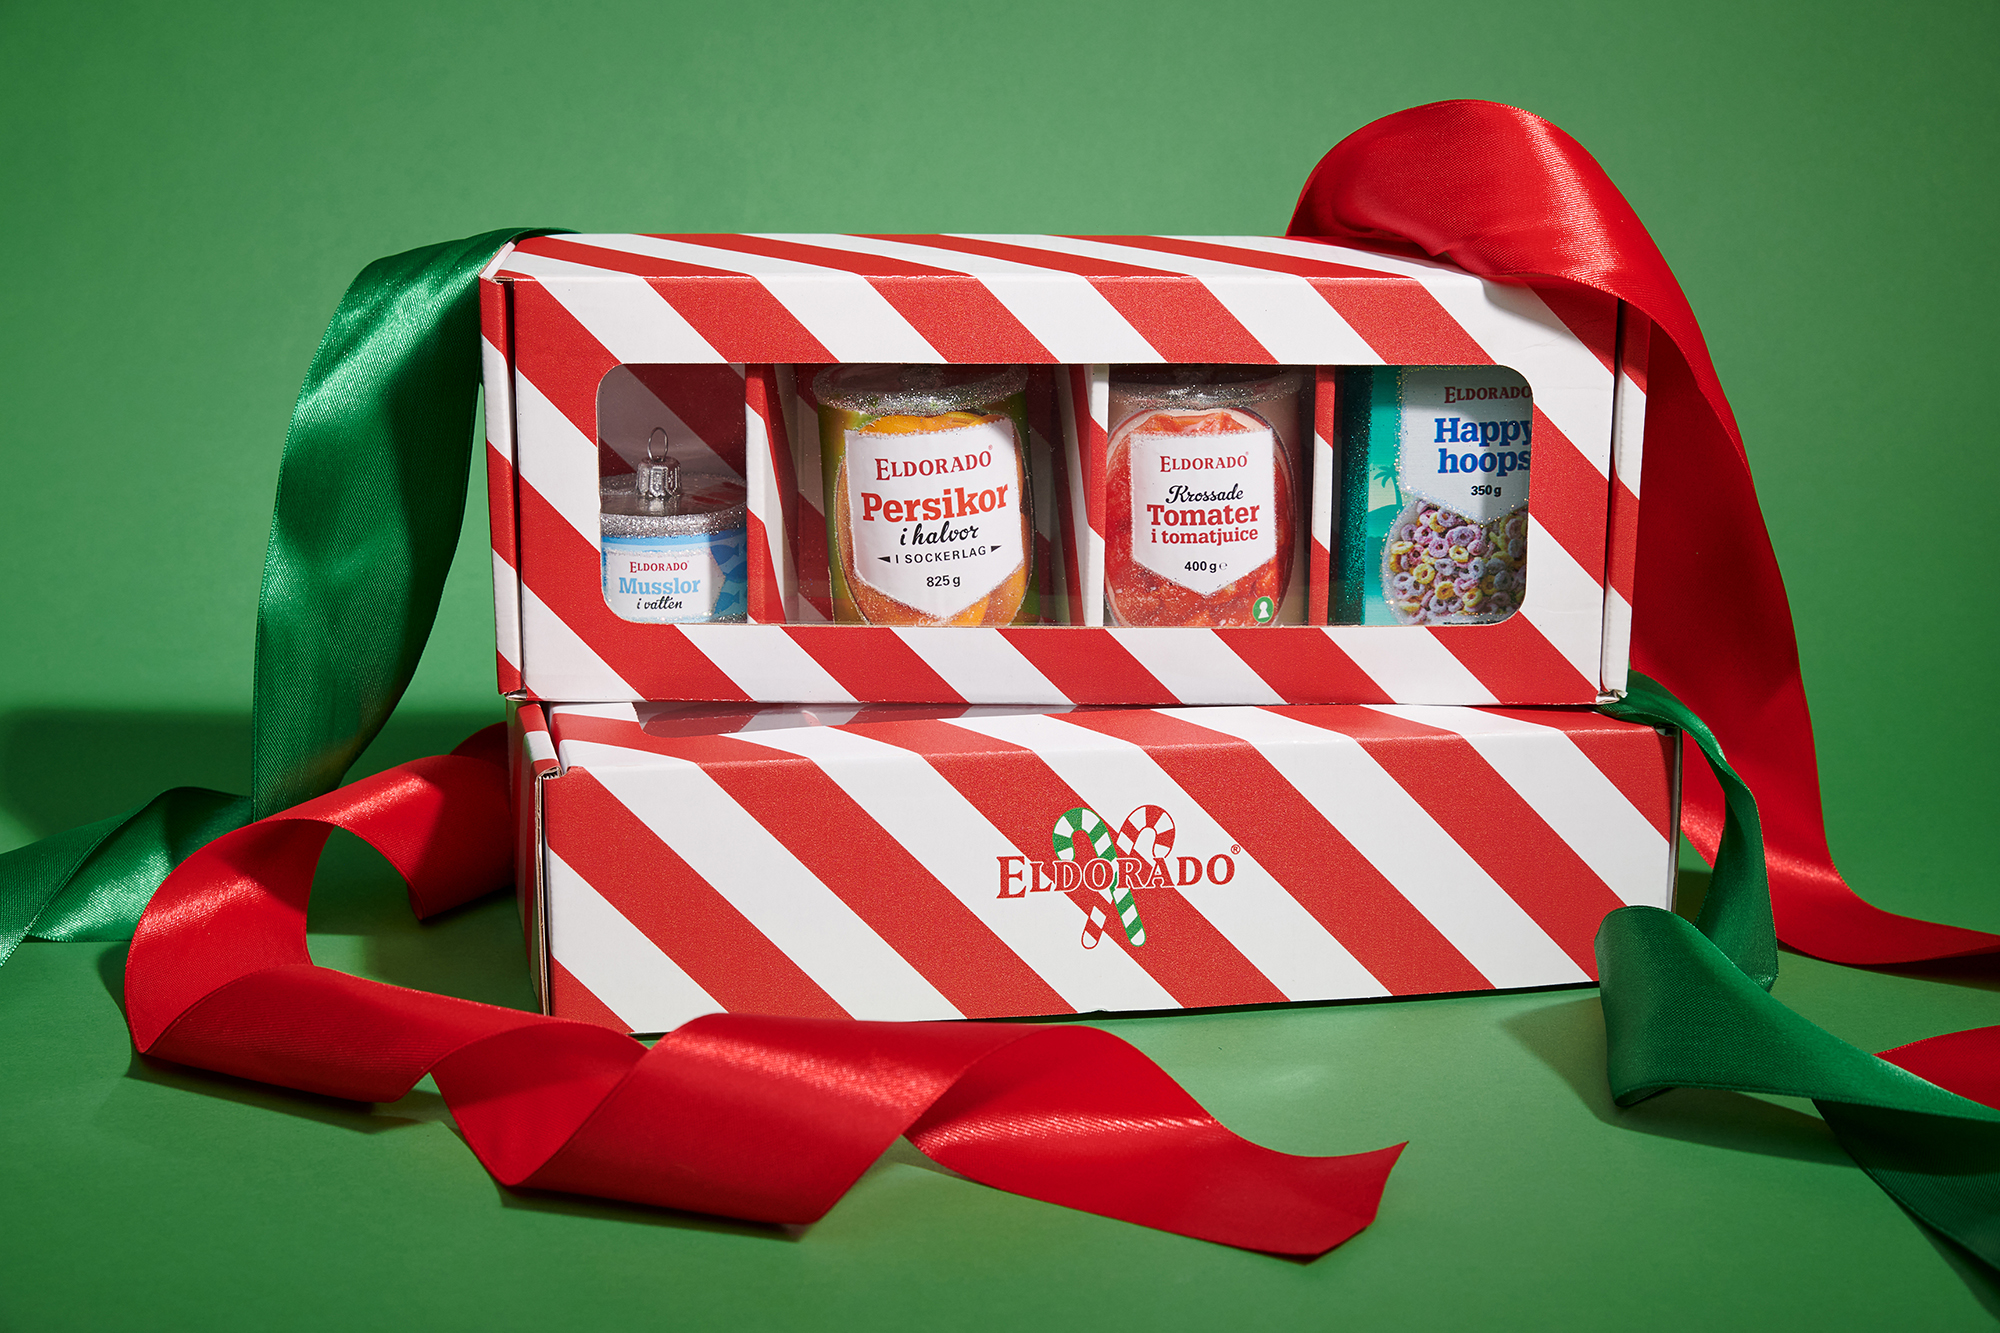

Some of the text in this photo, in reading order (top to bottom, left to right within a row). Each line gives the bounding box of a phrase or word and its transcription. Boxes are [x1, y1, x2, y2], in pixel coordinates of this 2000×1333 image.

[1434, 417, 1531, 447] Happy
[875, 450, 992, 481] ELDORADO
[1160, 455, 1247, 472] ELDORADO
[1437, 448, 1531, 477] hoops
[1165, 483, 1244, 504] Krossade
[1471, 485, 1502, 497] 350 g
[861, 484, 1008, 522] Persikor
[1146, 504, 1260, 527] Tomater
[900, 521, 980, 546] i halvor
[1151, 526, 1259, 547] i tomatjuice
[904, 546, 987, 564] SOCKERLAG
[629, 561, 689, 573] ELDORADO
[1184, 560, 1217, 573] 400 g
[618, 577, 701, 595] Musslor
[926, 575, 961, 588] 825 g
[636, 596, 683, 610] i vatten
[996, 854, 1236, 899] ELDORADO
